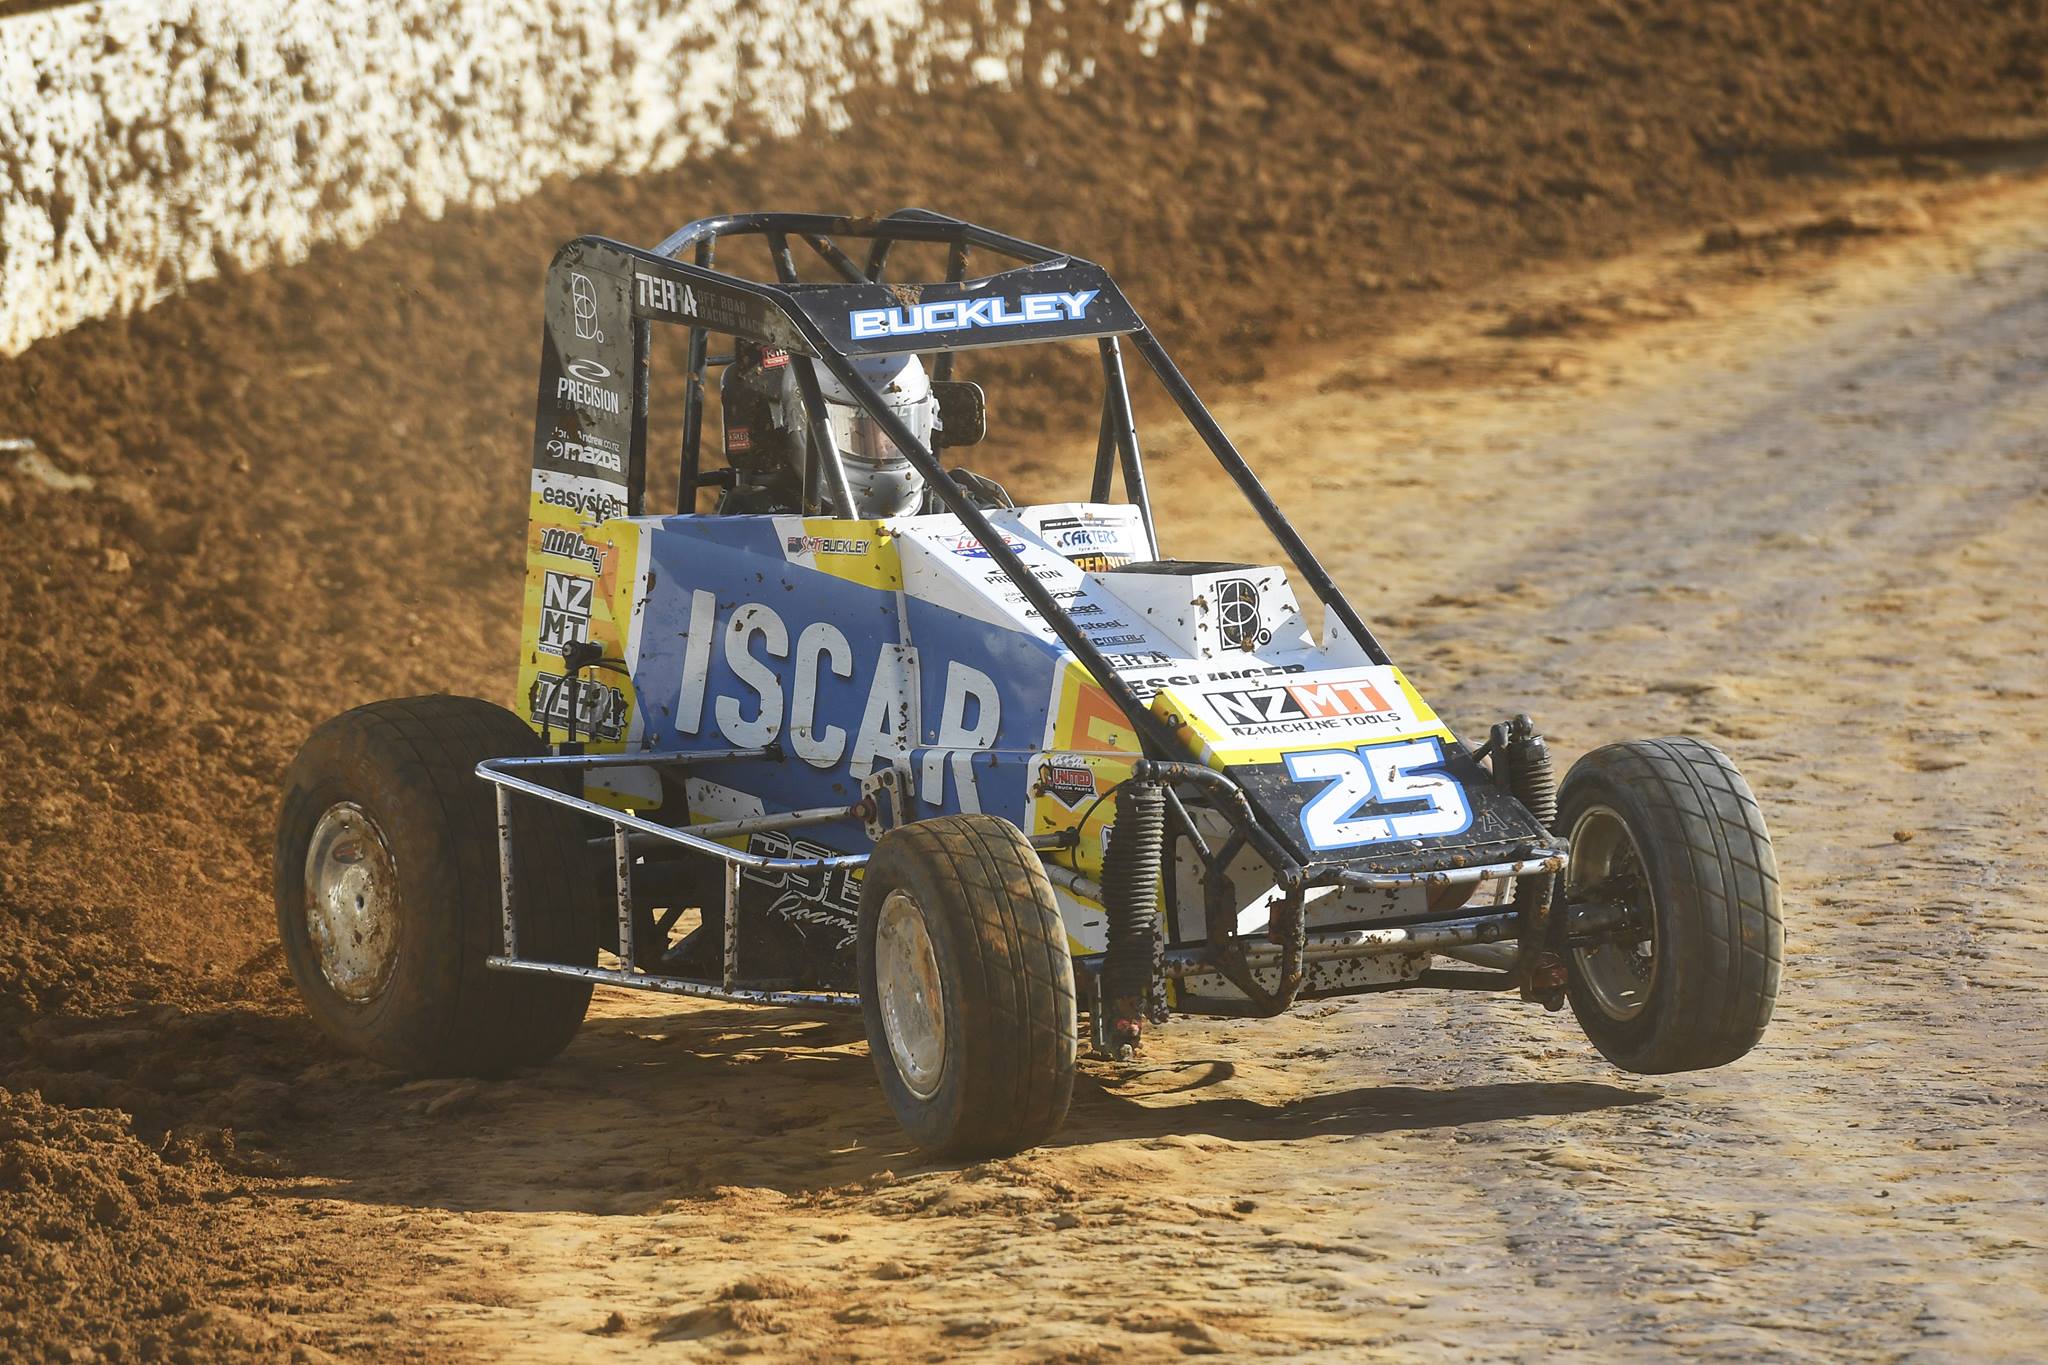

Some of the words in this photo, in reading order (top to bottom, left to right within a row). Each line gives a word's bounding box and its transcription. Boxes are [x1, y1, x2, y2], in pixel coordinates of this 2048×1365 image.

[850, 290, 1100, 340] BUCKLEY
[557, 377, 619, 414] PRECISION
[822, 539, 870, 554] BUCKLEY
[1062, 530, 1119, 547] CARTERS
[545, 573, 592, 616] NZ
[541, 609, 588, 645] MT
[674, 588, 1001, 815] ISCAR
[1281, 736, 1474, 851] 25
